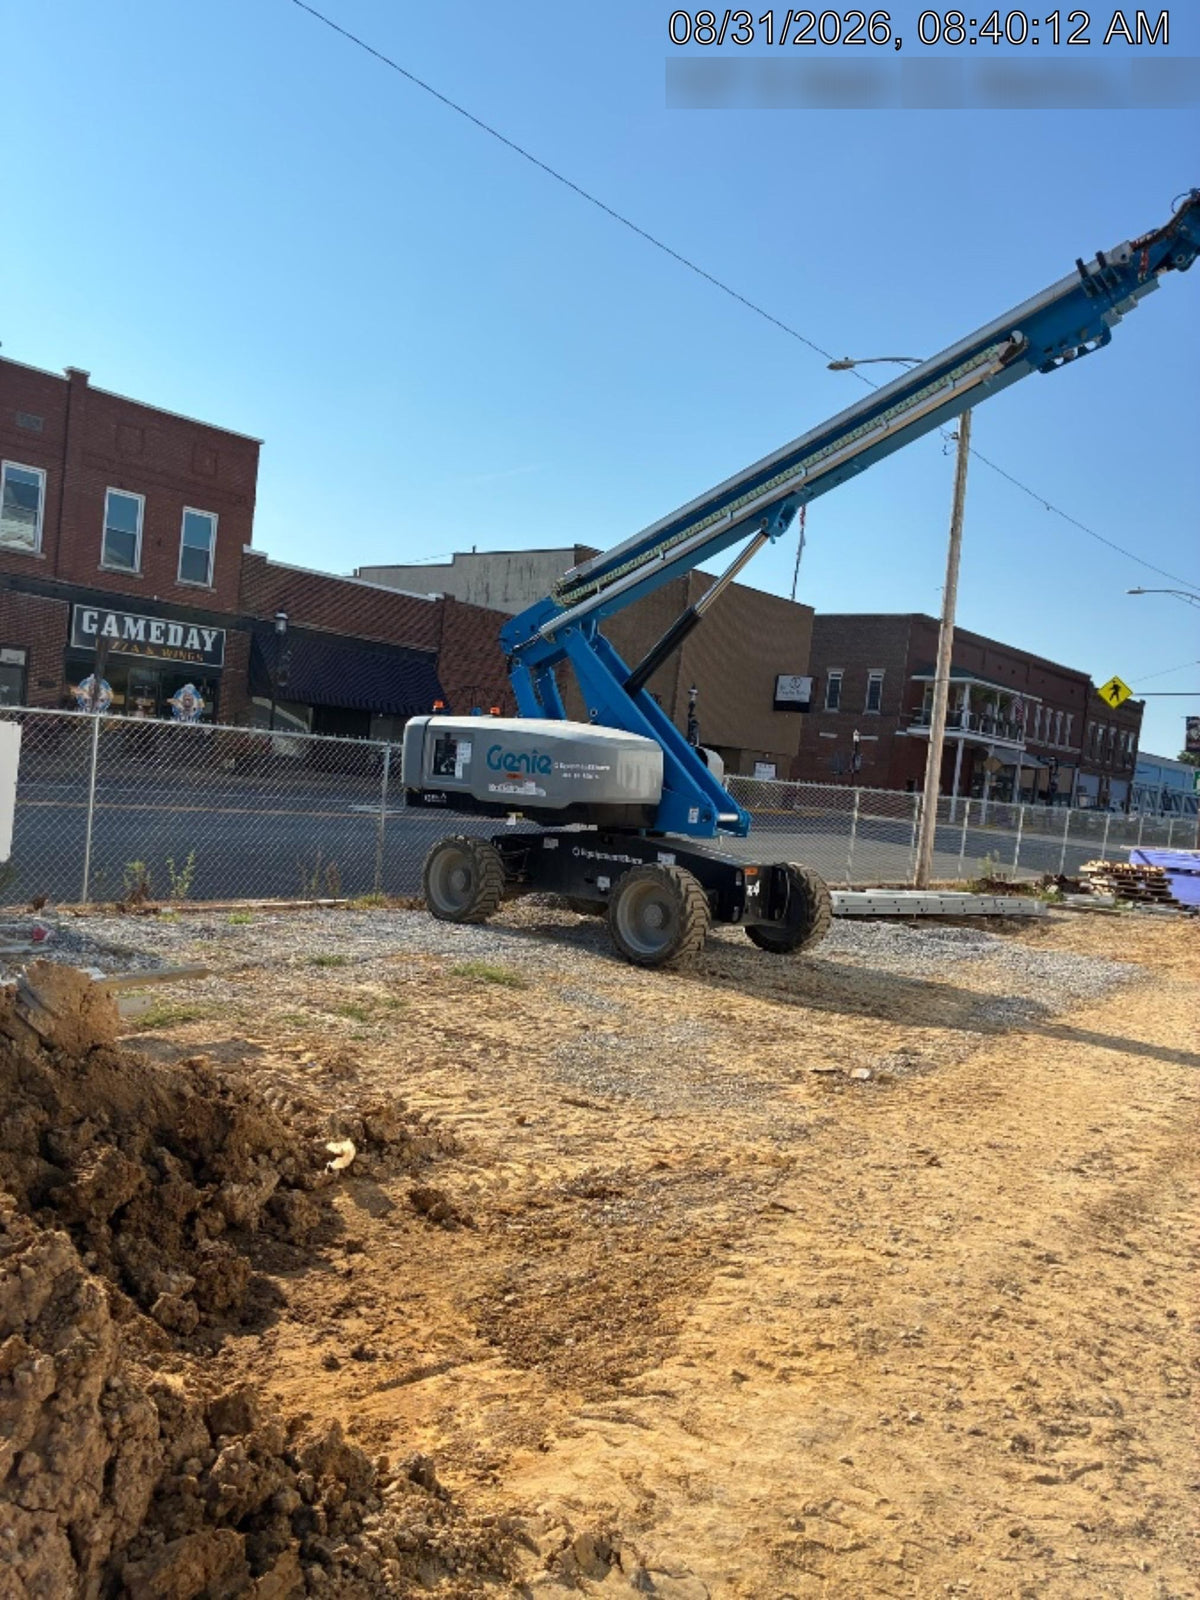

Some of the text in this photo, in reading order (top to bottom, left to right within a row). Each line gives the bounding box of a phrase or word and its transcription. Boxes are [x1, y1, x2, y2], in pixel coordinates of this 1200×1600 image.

[82, 610, 218, 652] GAMEDAY
[162, 647, 204, 662] WINGS
[486, 744, 552, 775] Genie
